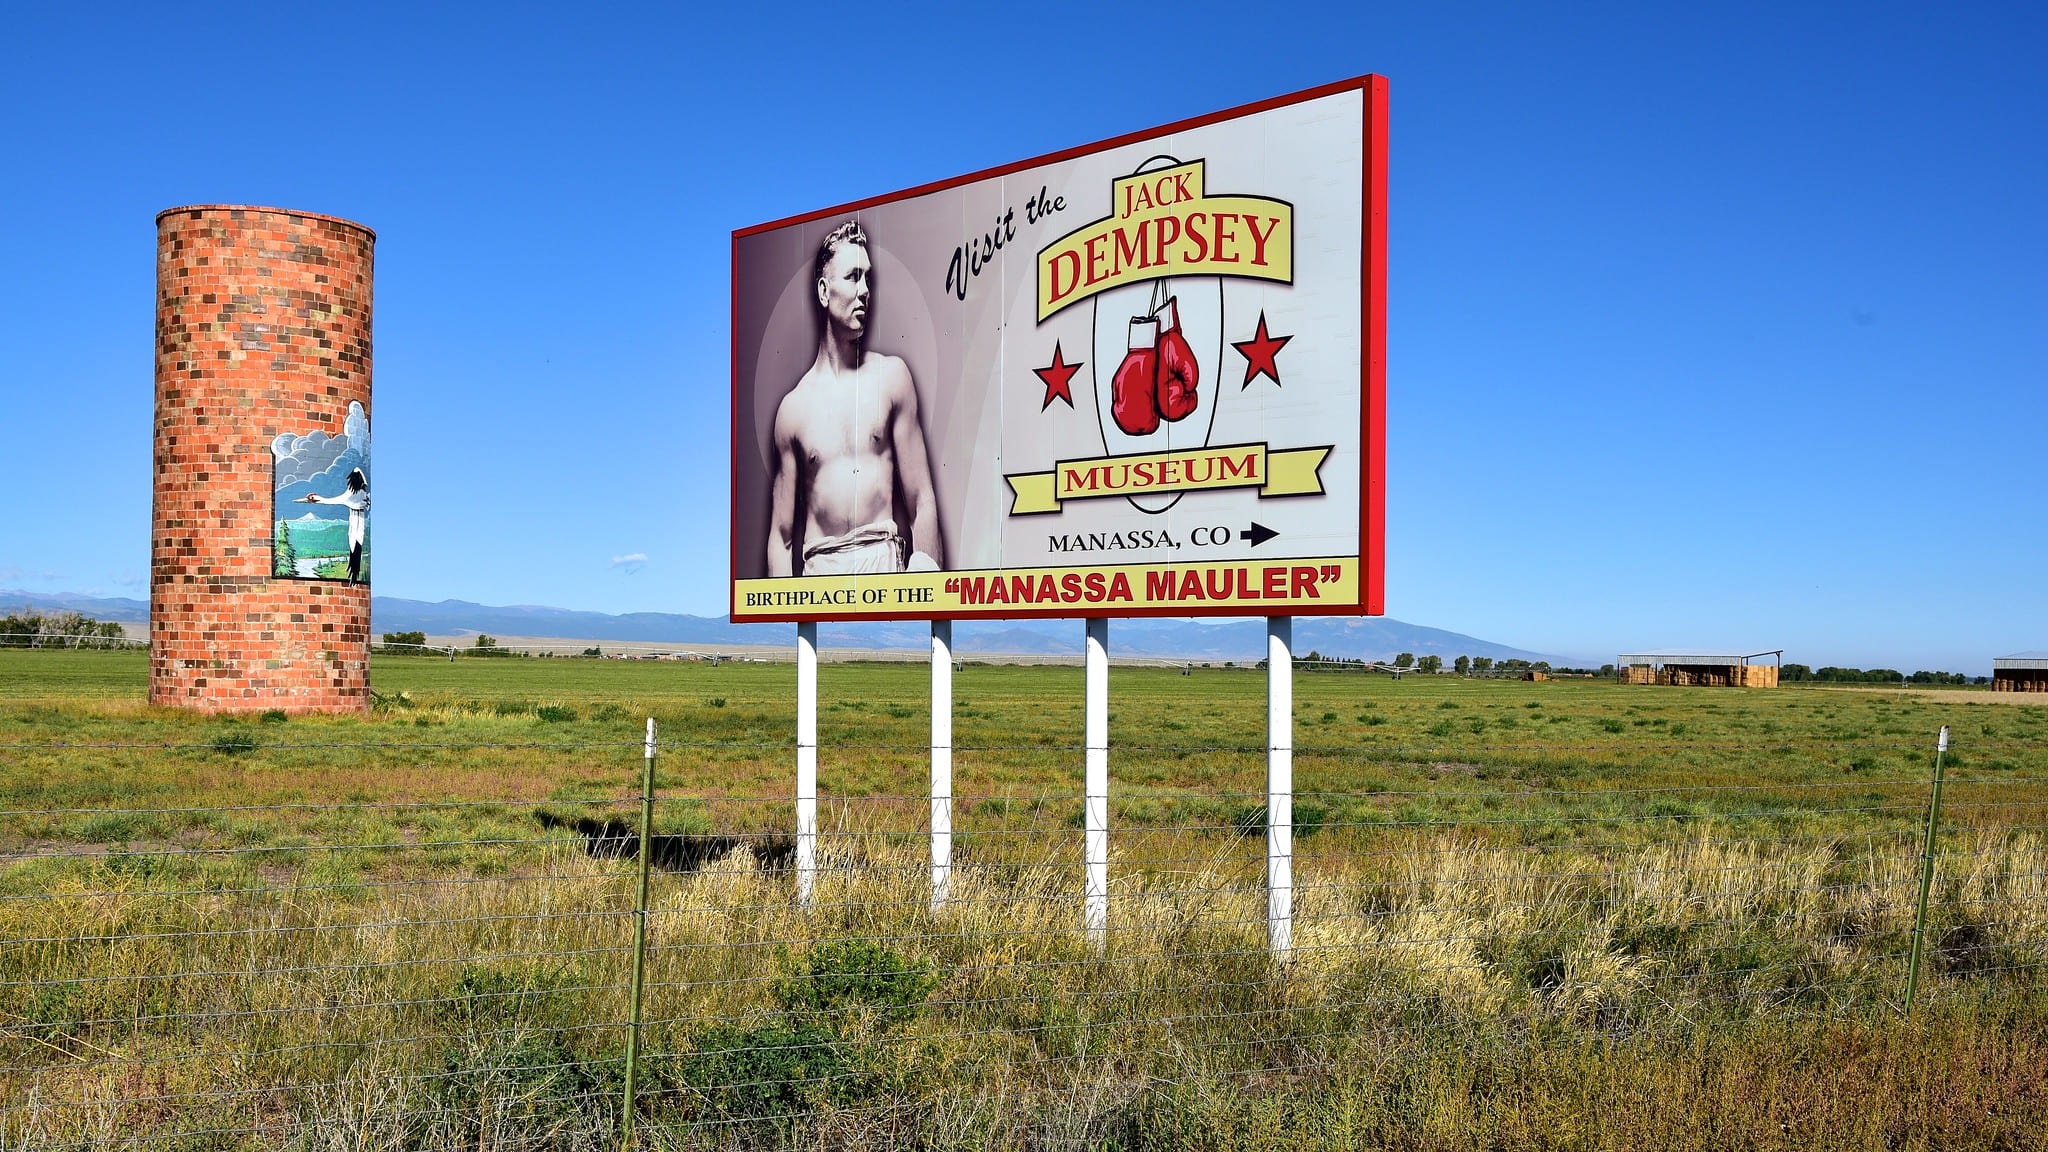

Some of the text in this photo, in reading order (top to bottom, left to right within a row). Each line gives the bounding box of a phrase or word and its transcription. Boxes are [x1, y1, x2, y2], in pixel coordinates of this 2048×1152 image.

[1121, 171, 1194, 220] JACK
[945, 185, 1067, 301] Visit the
[1047, 212, 1281, 305] DEMPSEY
[1063, 453, 1259, 492] MUSEUM
[1048, 526, 1231, 553] MANASSA, CO
[745, 565, 1342, 607] BIRTHPLACE OF THE “MANASSA MAULER”
